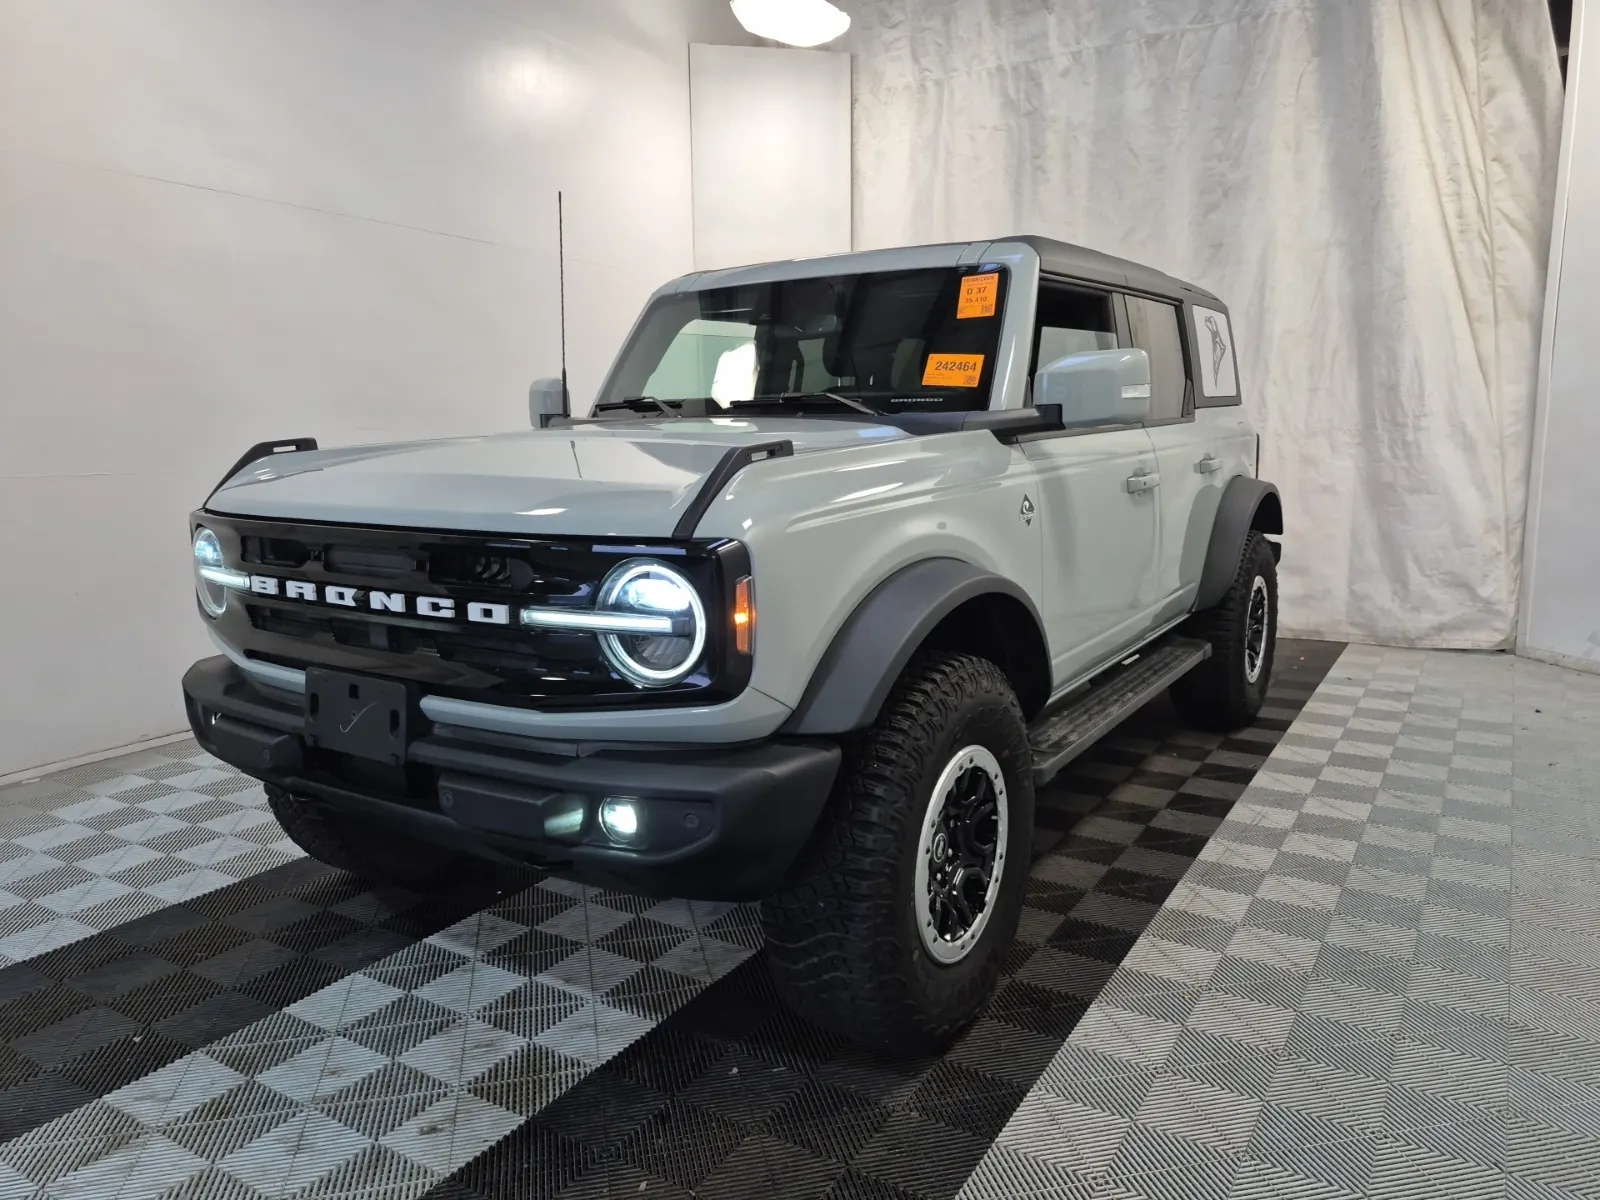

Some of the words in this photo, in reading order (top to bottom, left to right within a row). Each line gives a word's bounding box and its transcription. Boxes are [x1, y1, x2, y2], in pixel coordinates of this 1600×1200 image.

[976, 286, 987, 294] 37
[935, 361, 977, 372] 242464
[250, 575, 510, 625] BRONCO
